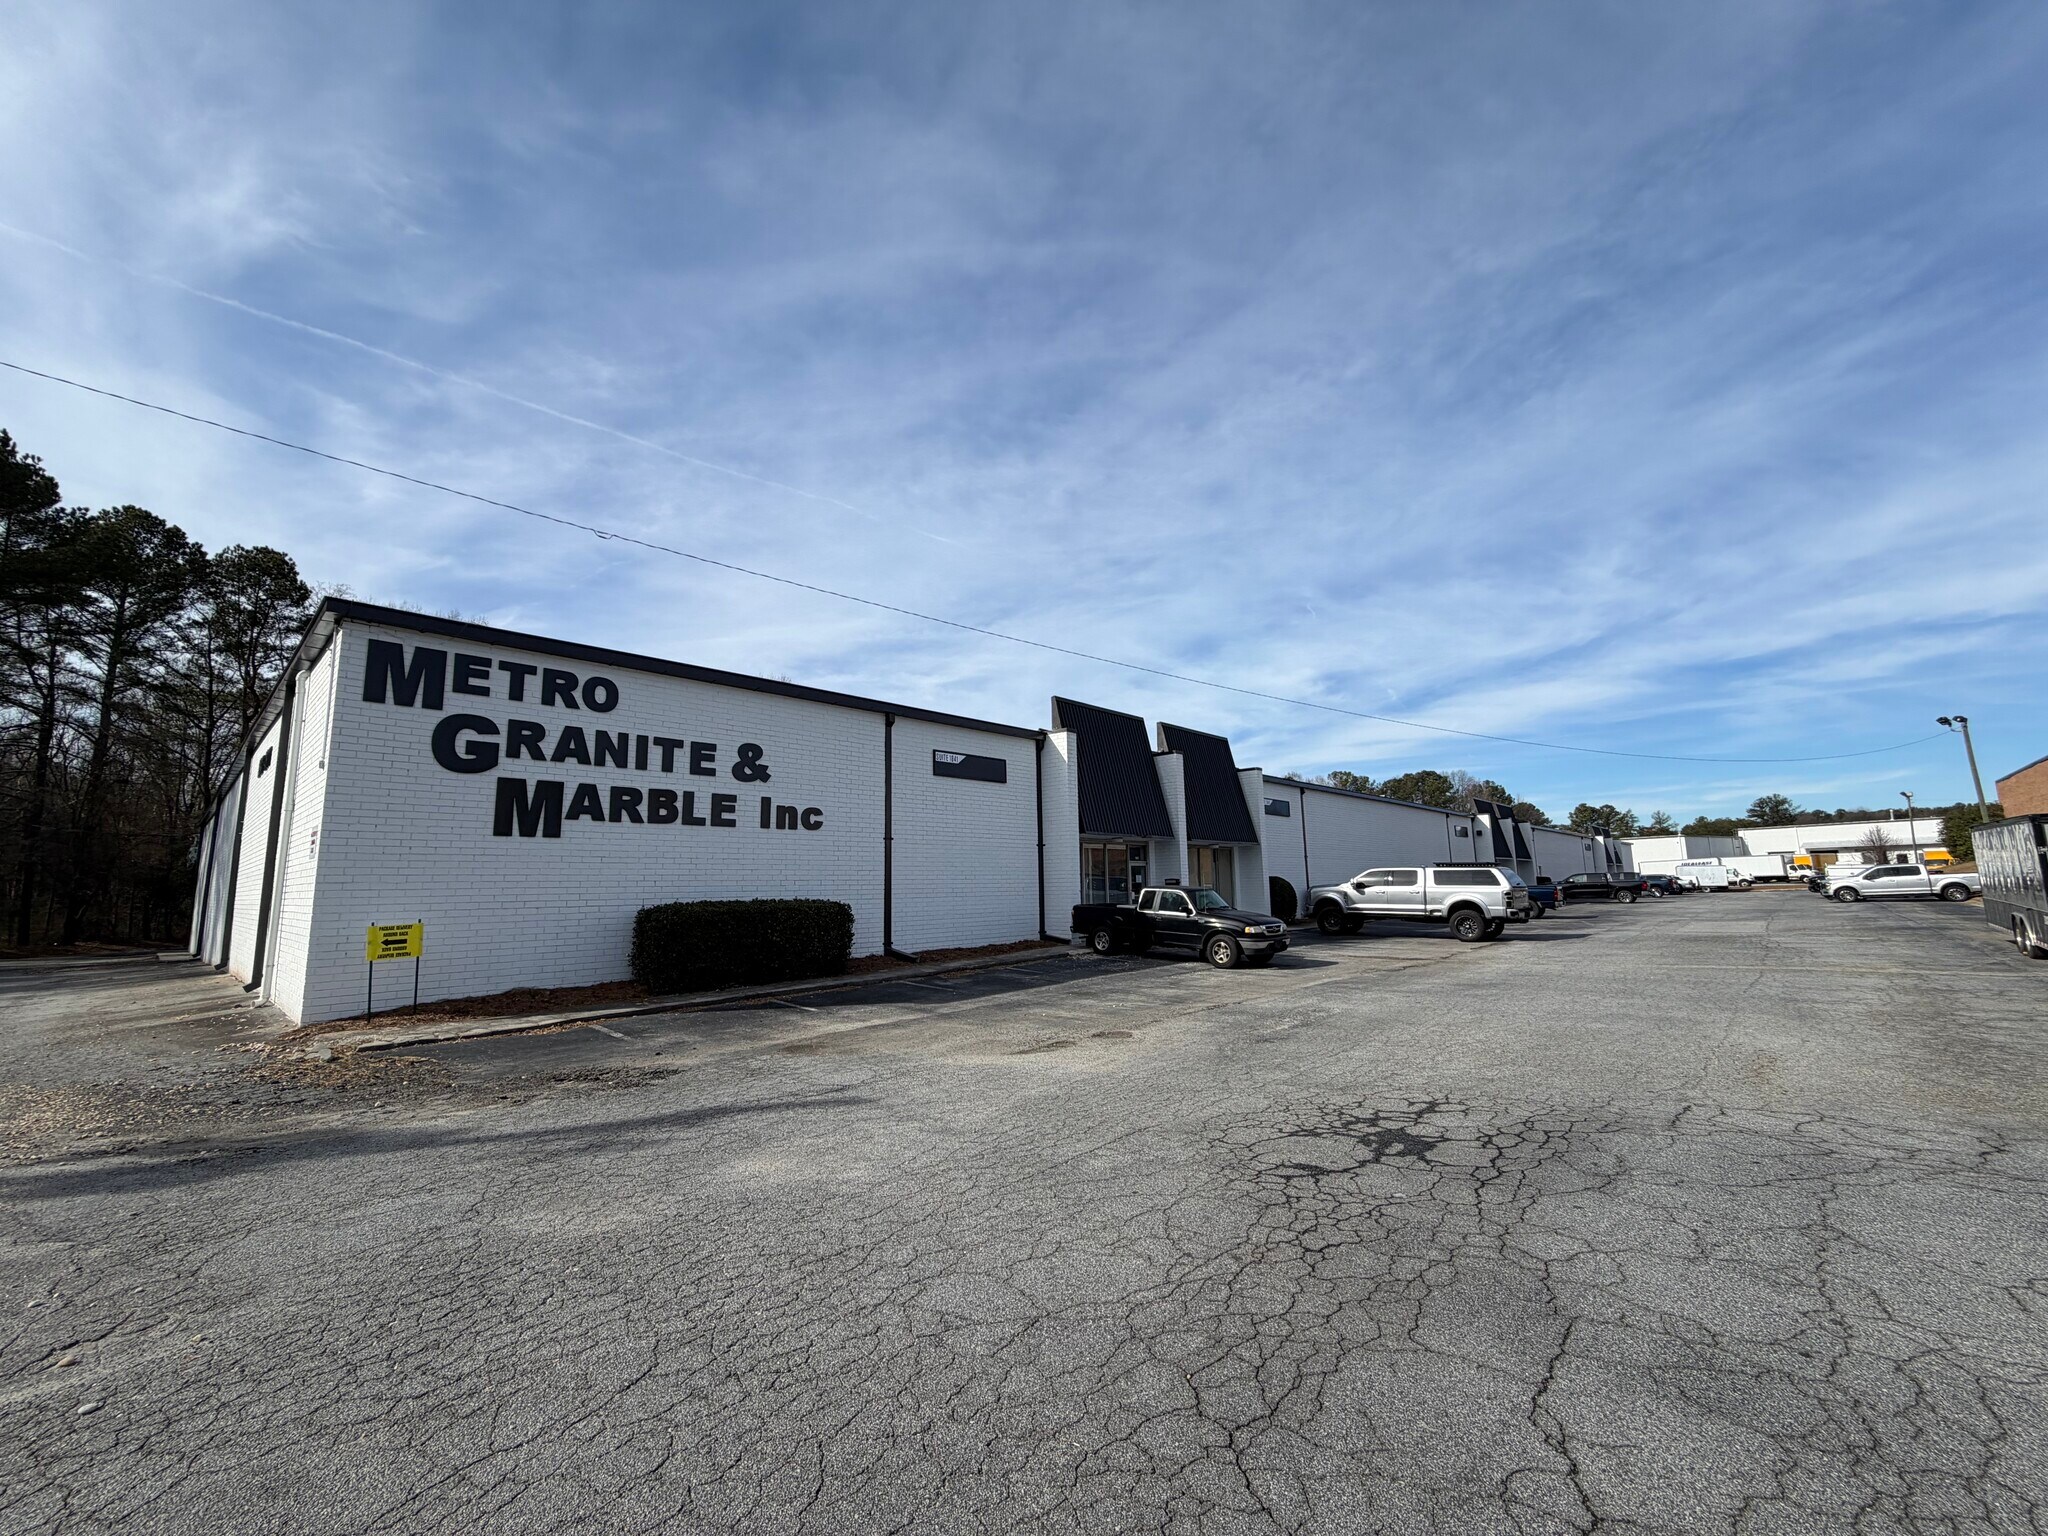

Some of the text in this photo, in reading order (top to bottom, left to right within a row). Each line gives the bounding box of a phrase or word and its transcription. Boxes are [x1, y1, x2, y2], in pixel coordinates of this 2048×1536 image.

[362, 638, 619, 713] METRO
[431, 713, 772, 783] GRANITE &
[936, 753, 949, 761] SUITE
[493, 777, 823, 838] MARBLE Inc
